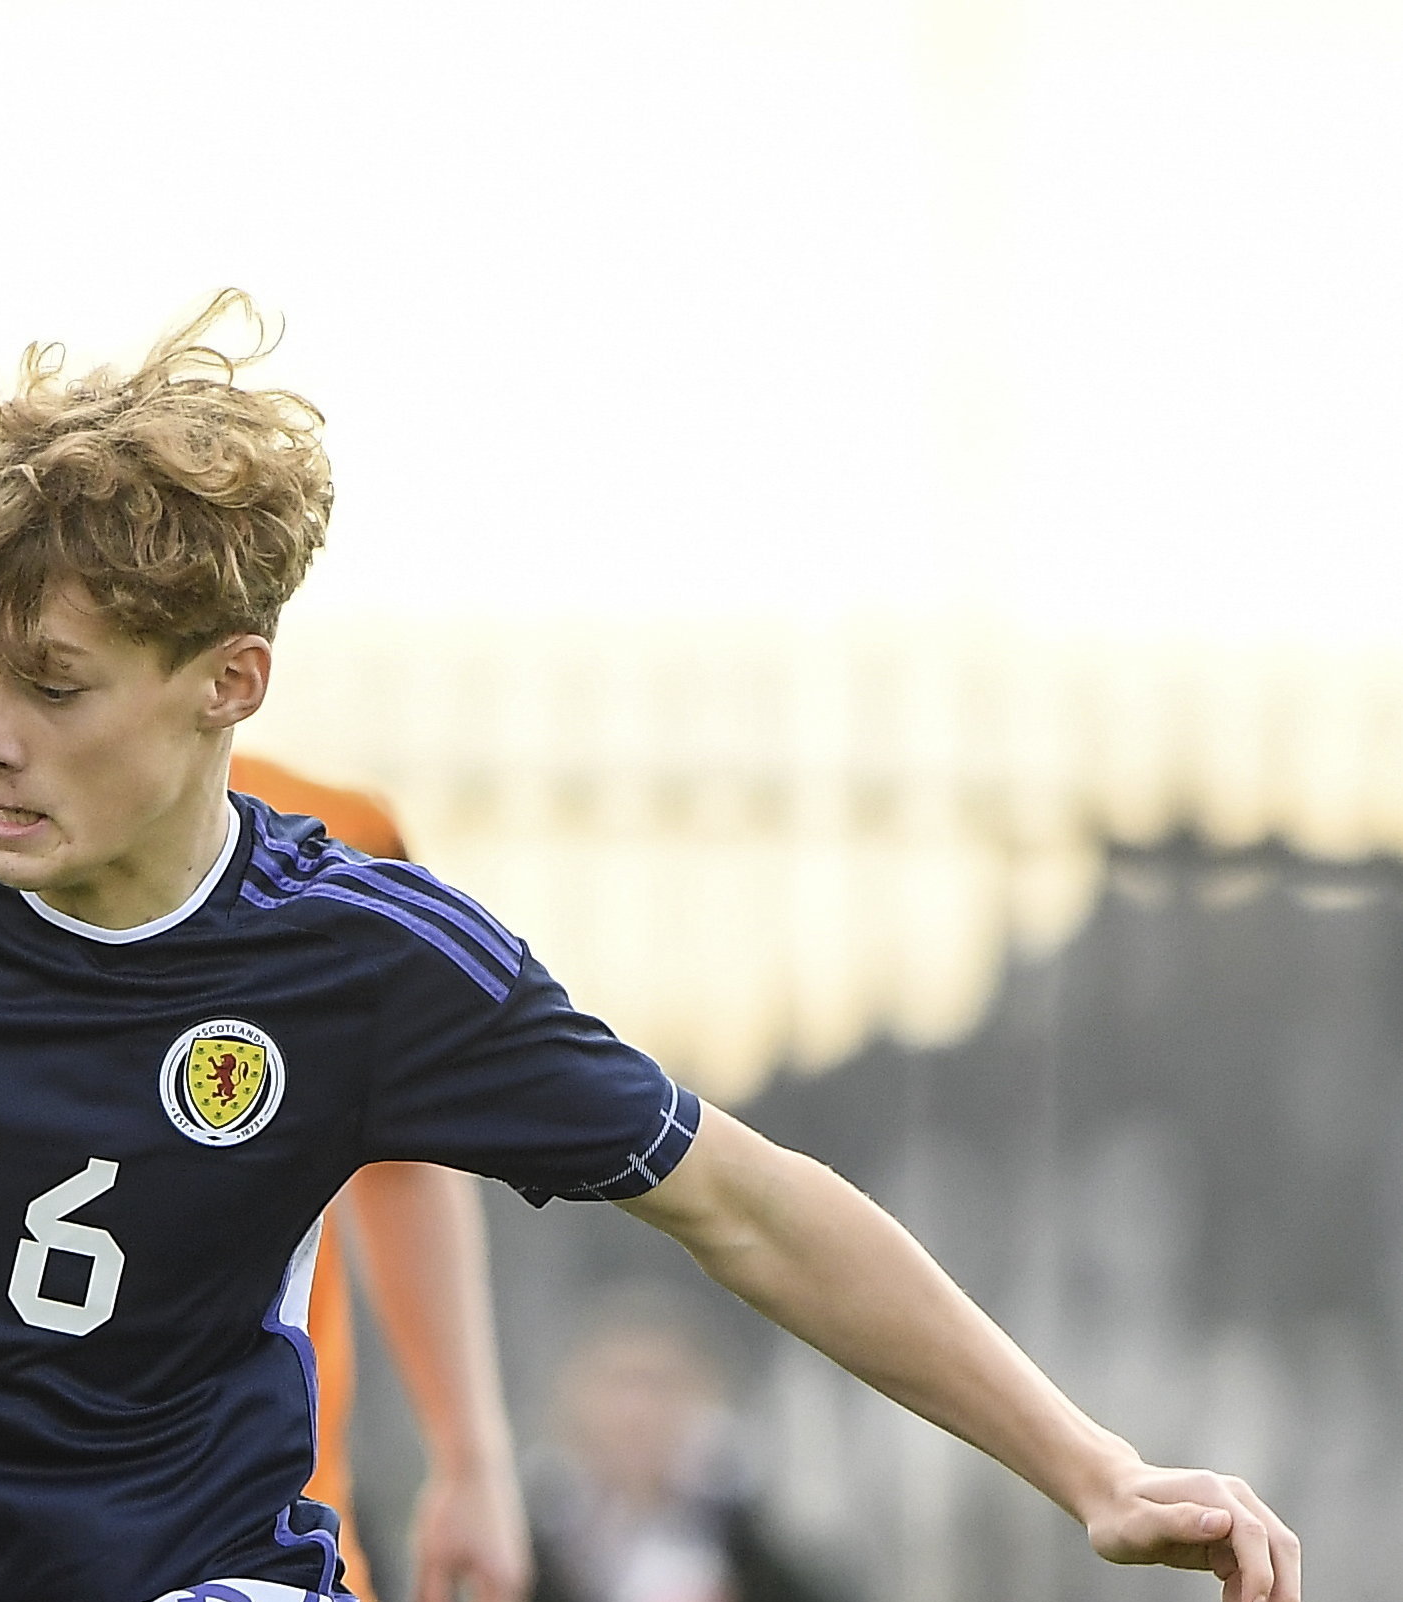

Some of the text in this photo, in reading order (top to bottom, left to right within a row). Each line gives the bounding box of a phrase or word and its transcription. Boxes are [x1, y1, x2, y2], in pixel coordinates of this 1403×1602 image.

[201, 1024, 261, 1043] SCOTLAND
[173, 1113, 190, 1129] EST
[240, 1120, 261, 1138] 1873
